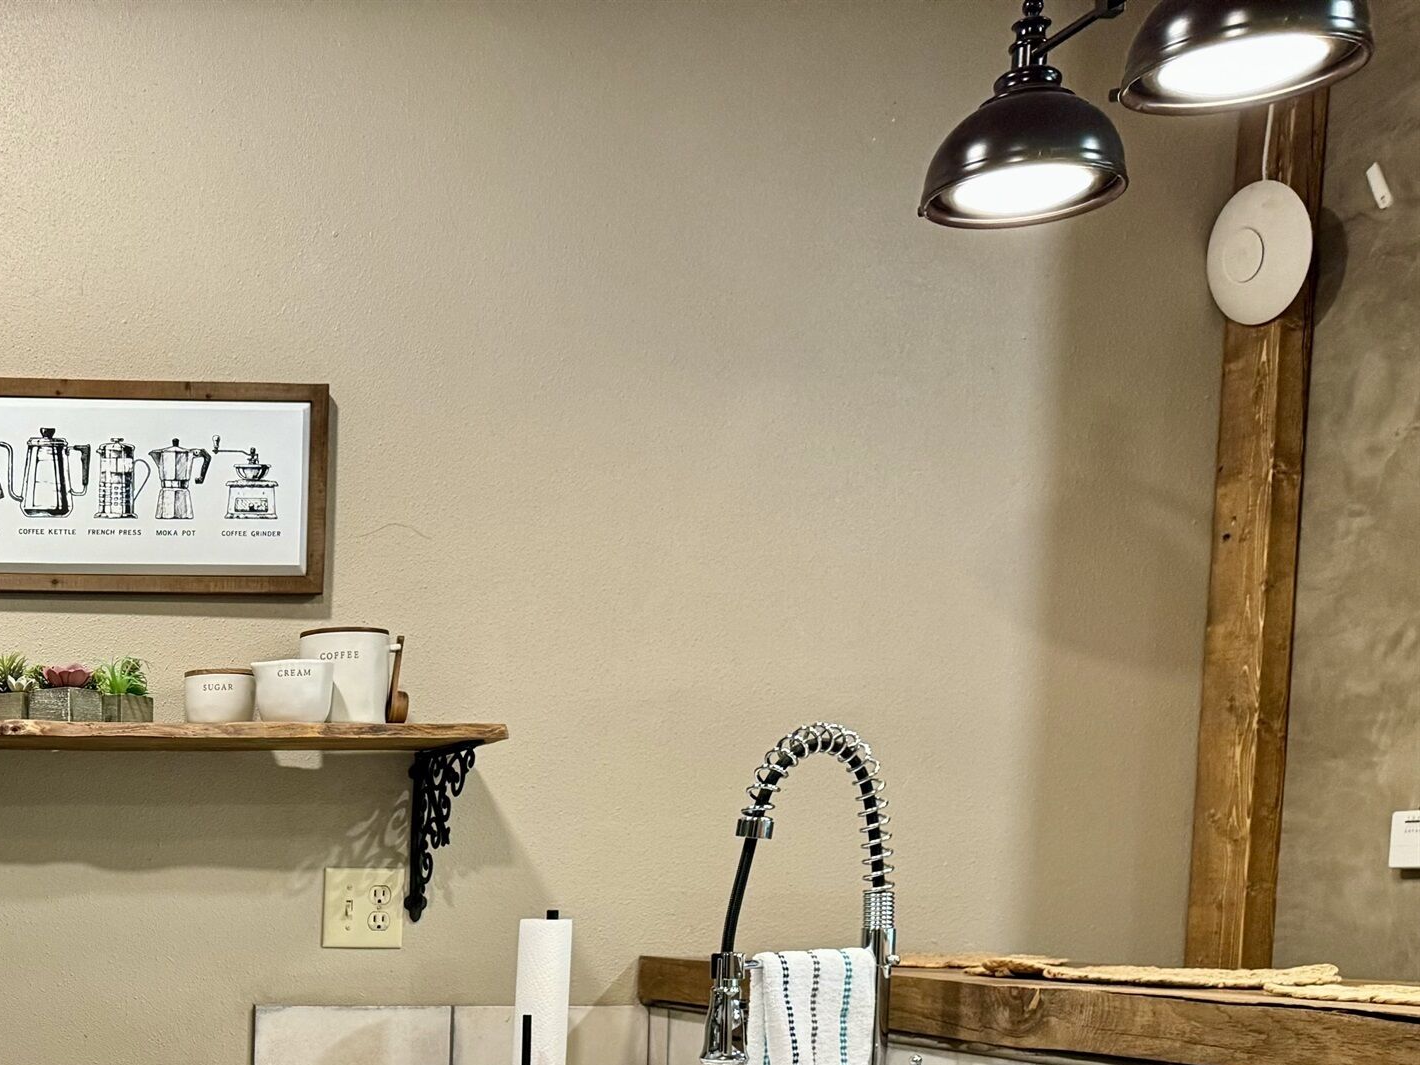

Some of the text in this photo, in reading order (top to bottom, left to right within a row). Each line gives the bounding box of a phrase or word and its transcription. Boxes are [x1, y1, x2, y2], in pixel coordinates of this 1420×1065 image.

[319, 650, 360, 661] COFFEE
[277, 668, 312, 678] CREAM
[202, 683, 234, 692] SUGAR
